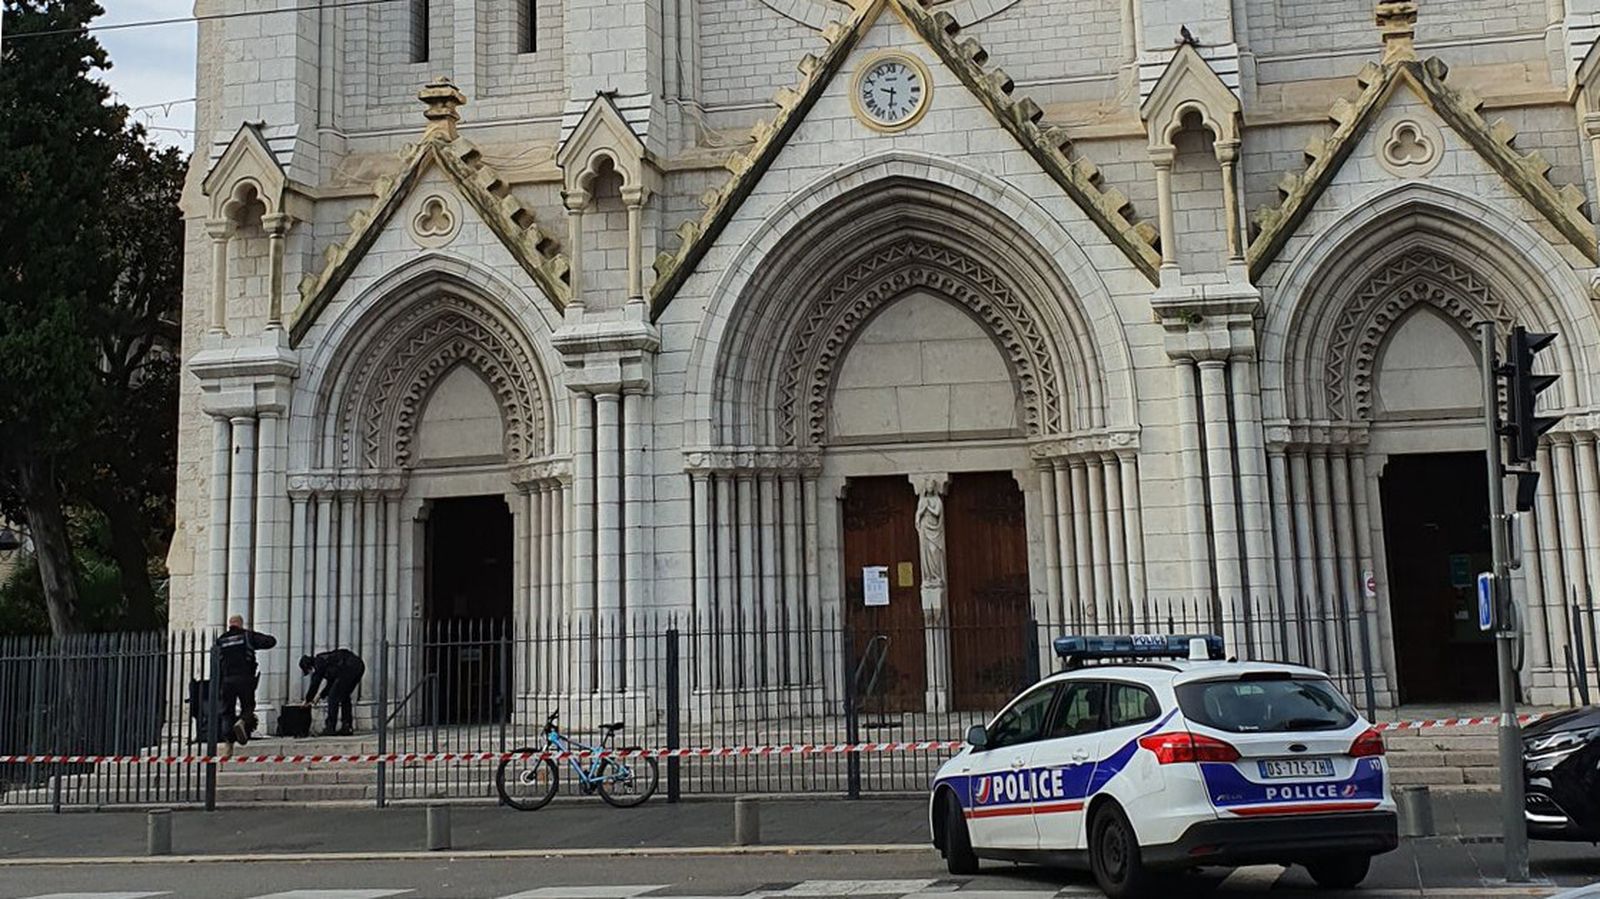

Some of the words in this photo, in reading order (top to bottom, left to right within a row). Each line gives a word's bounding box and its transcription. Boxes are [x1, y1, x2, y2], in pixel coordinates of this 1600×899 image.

[1133, 635, 1166, 646] POLICE
[993, 769, 1065, 802] POLICE
[1265, 785, 1338, 800] POLICE
